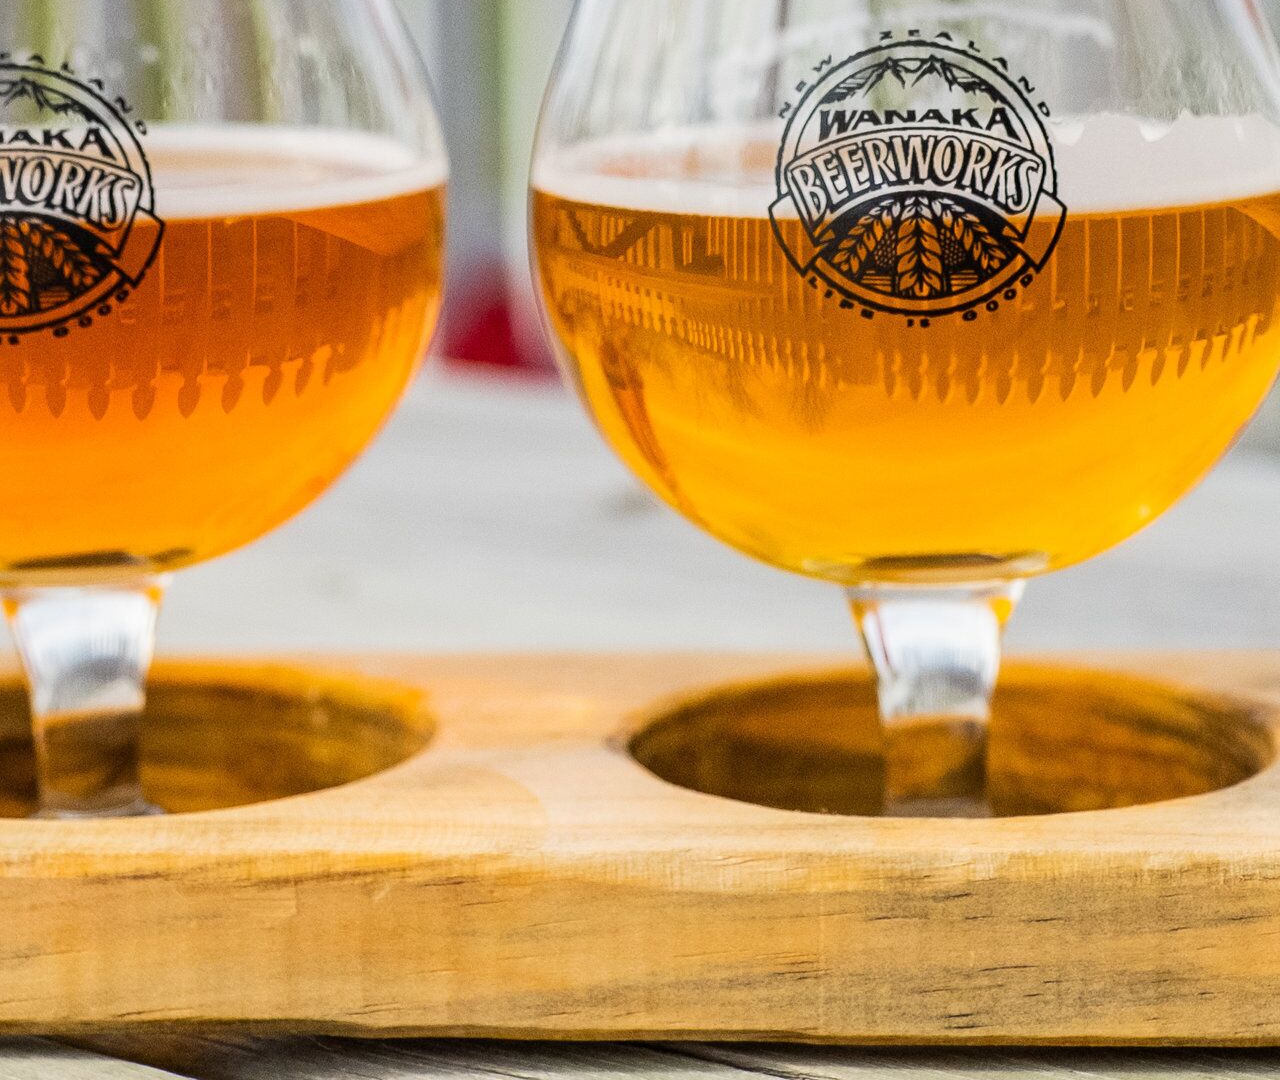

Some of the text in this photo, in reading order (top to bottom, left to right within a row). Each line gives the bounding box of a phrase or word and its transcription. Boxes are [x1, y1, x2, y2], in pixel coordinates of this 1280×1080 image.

[879, 29, 1051, 117] ZEALAND
[818, 107, 1022, 143] WANAKA
[790, 135, 1039, 221] BEERWORKS
